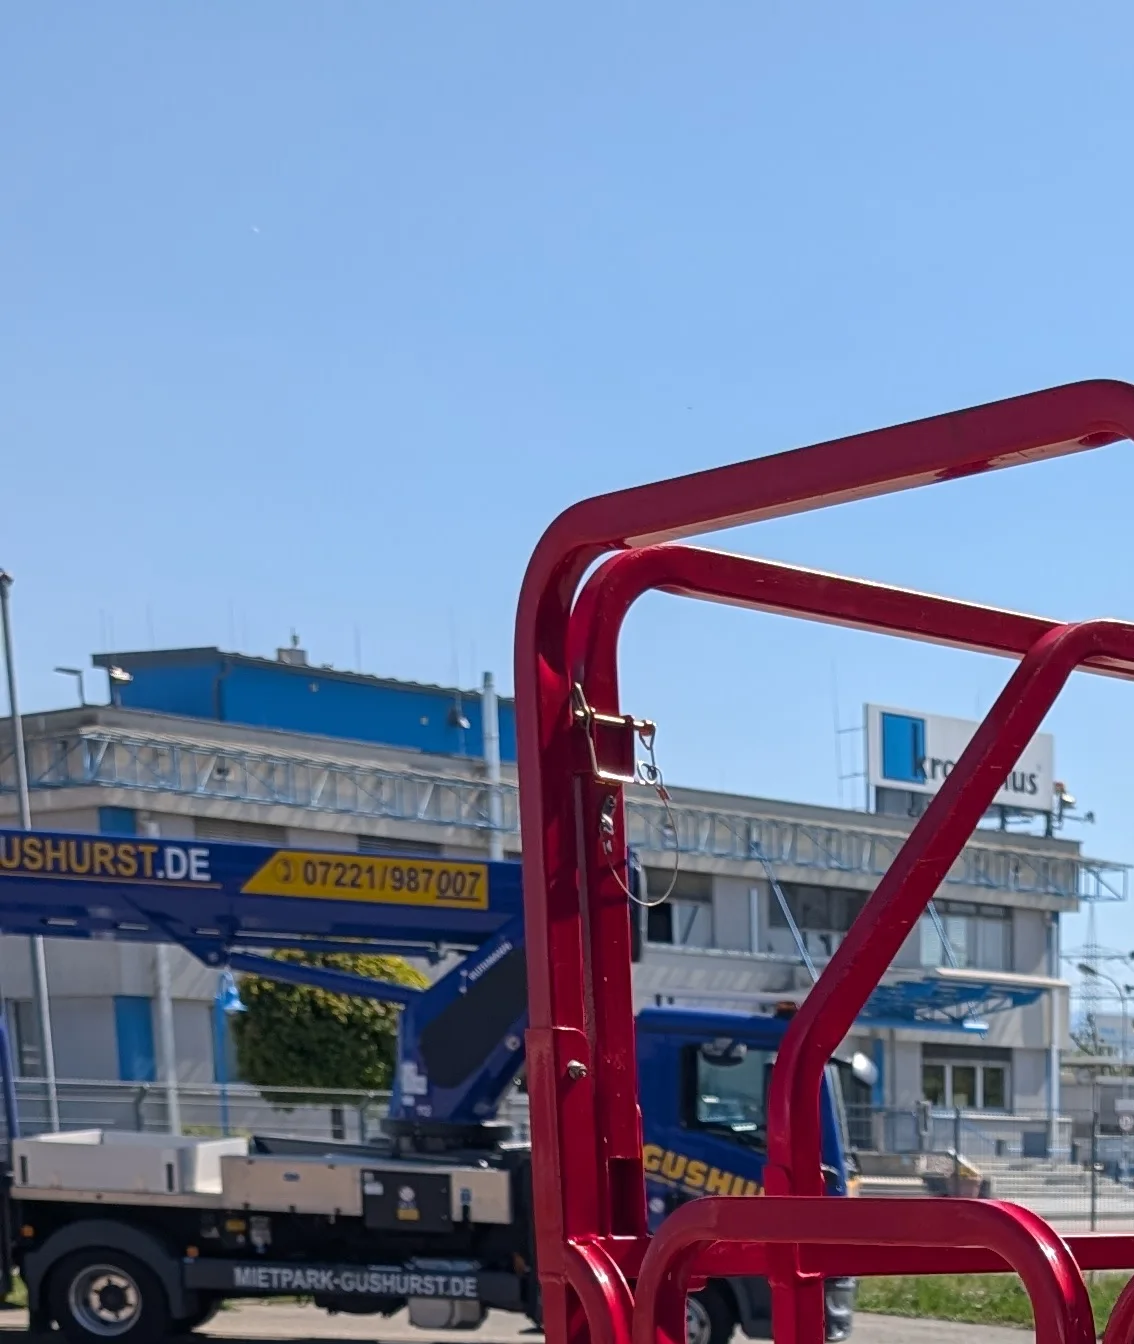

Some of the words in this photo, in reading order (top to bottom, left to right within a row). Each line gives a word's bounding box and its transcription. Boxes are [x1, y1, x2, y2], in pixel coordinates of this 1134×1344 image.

[912, 722, 1038, 795] krous
[303, 859, 483, 899] 07221/987007
[643, 1144, 765, 1196] GUSHU
[233, 1266, 479, 1298] MIETPARK-GUSHURST.DE
